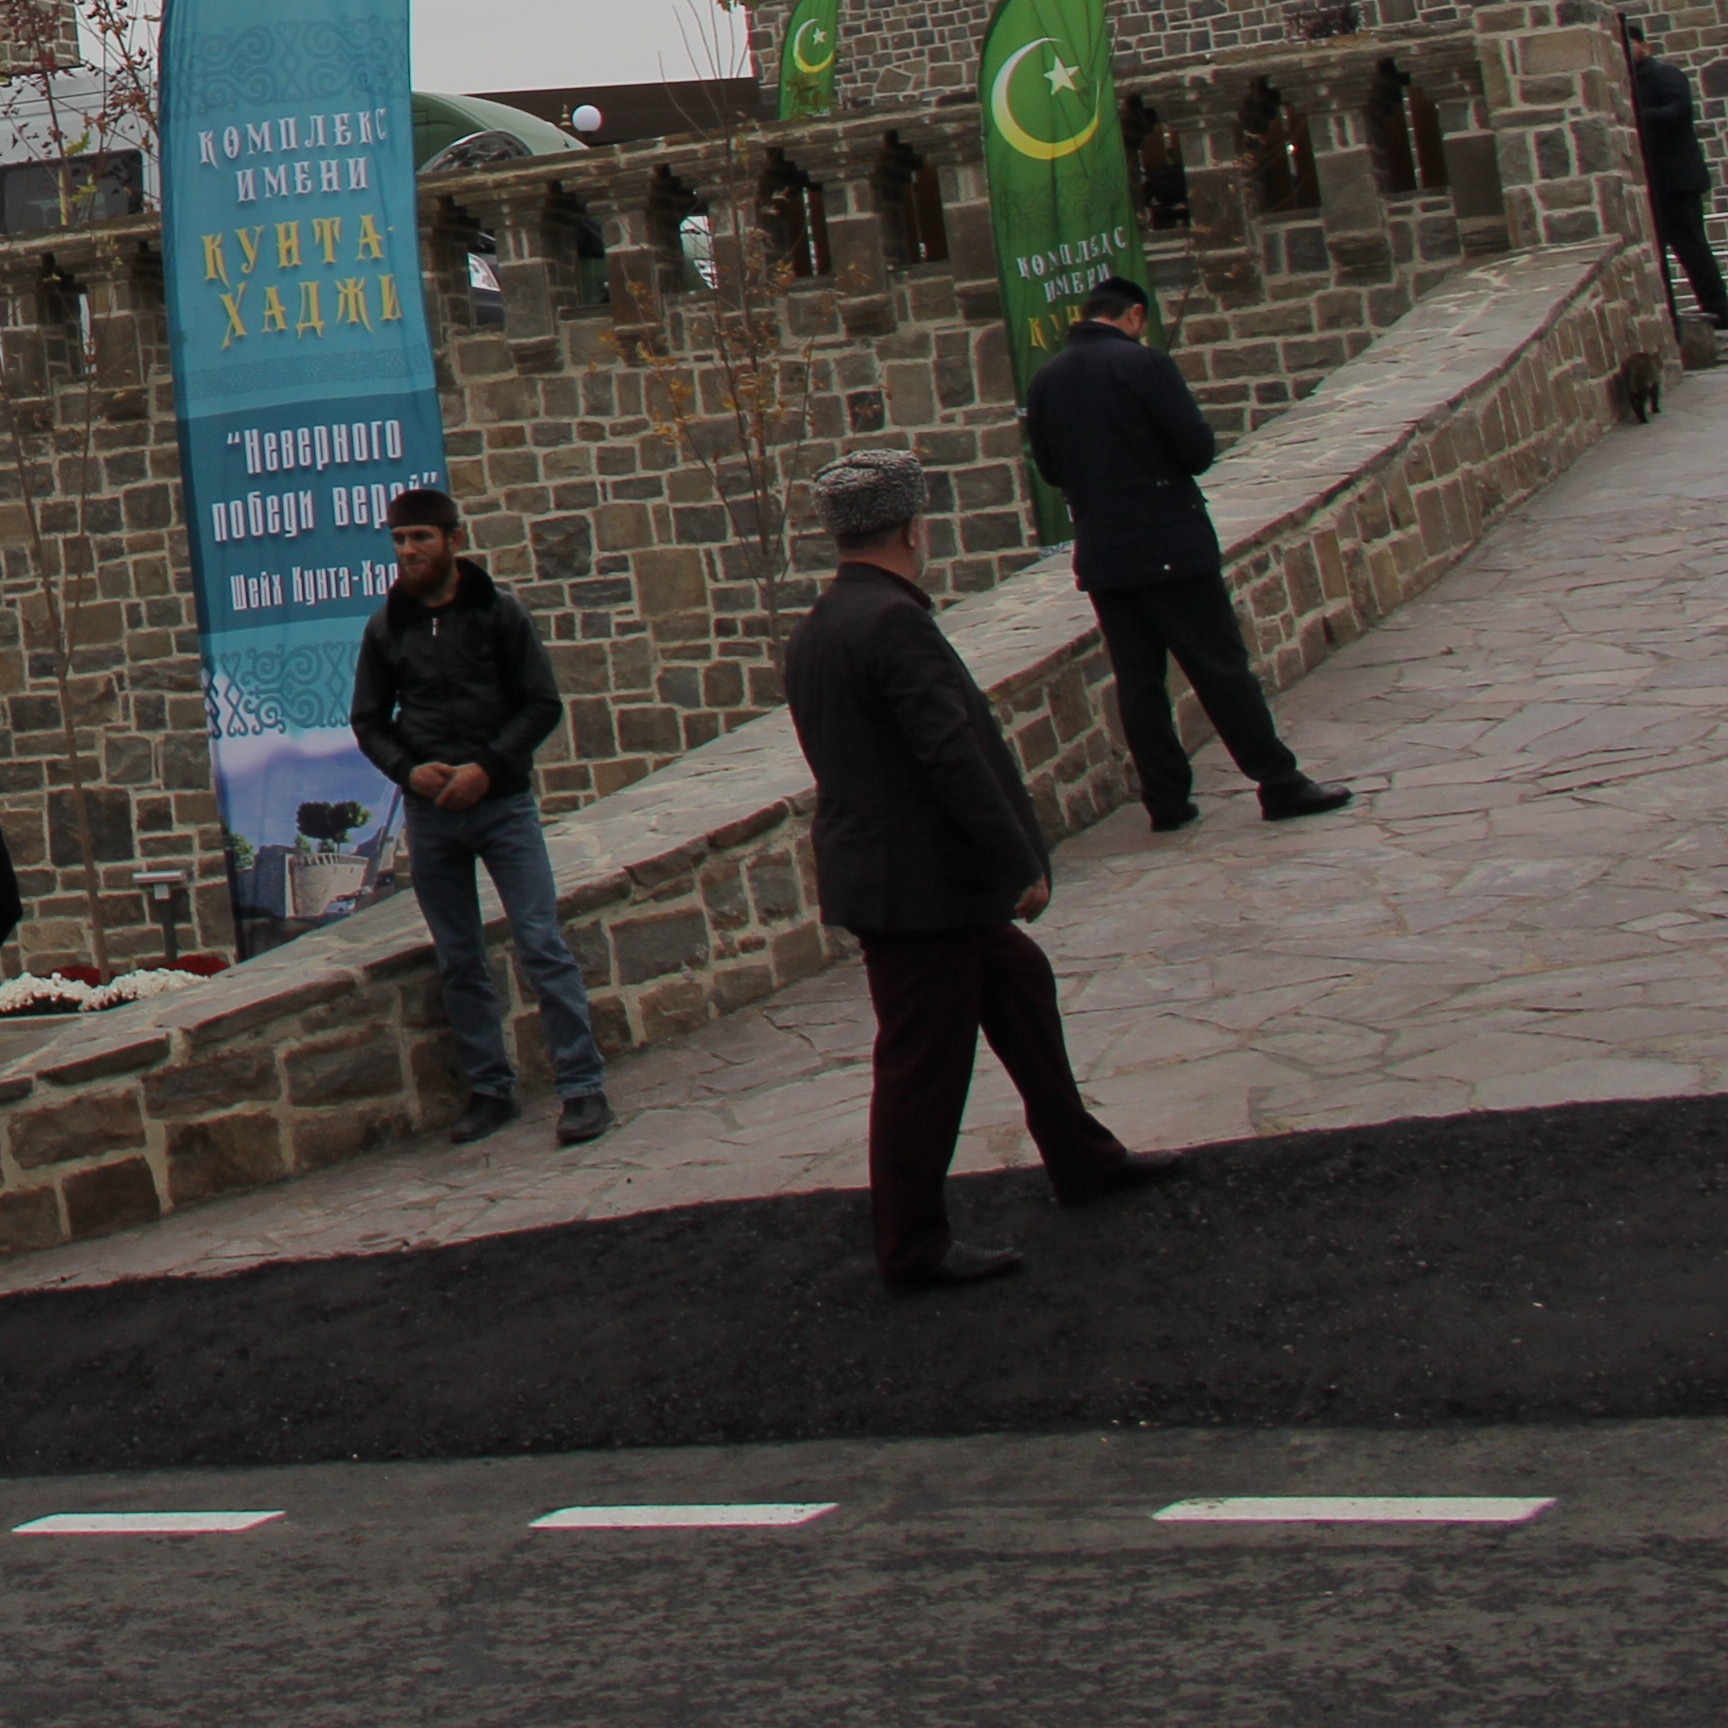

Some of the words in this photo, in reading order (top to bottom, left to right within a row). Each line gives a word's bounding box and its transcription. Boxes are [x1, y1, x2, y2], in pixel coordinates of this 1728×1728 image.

[197, 108, 387, 169] КОМПЛЕКС
[236, 156, 370, 203] ИМЕНИ
[201, 213, 397, 289] КУНТА-
[218, 274, 403, 351] ХАДЖИ
[211, 489, 315, 543] победи
[332, 471, 438, 530] вер”
[230, 571, 285, 612] Шейх
[291, 559, 399, 606] Кунта-Ха
